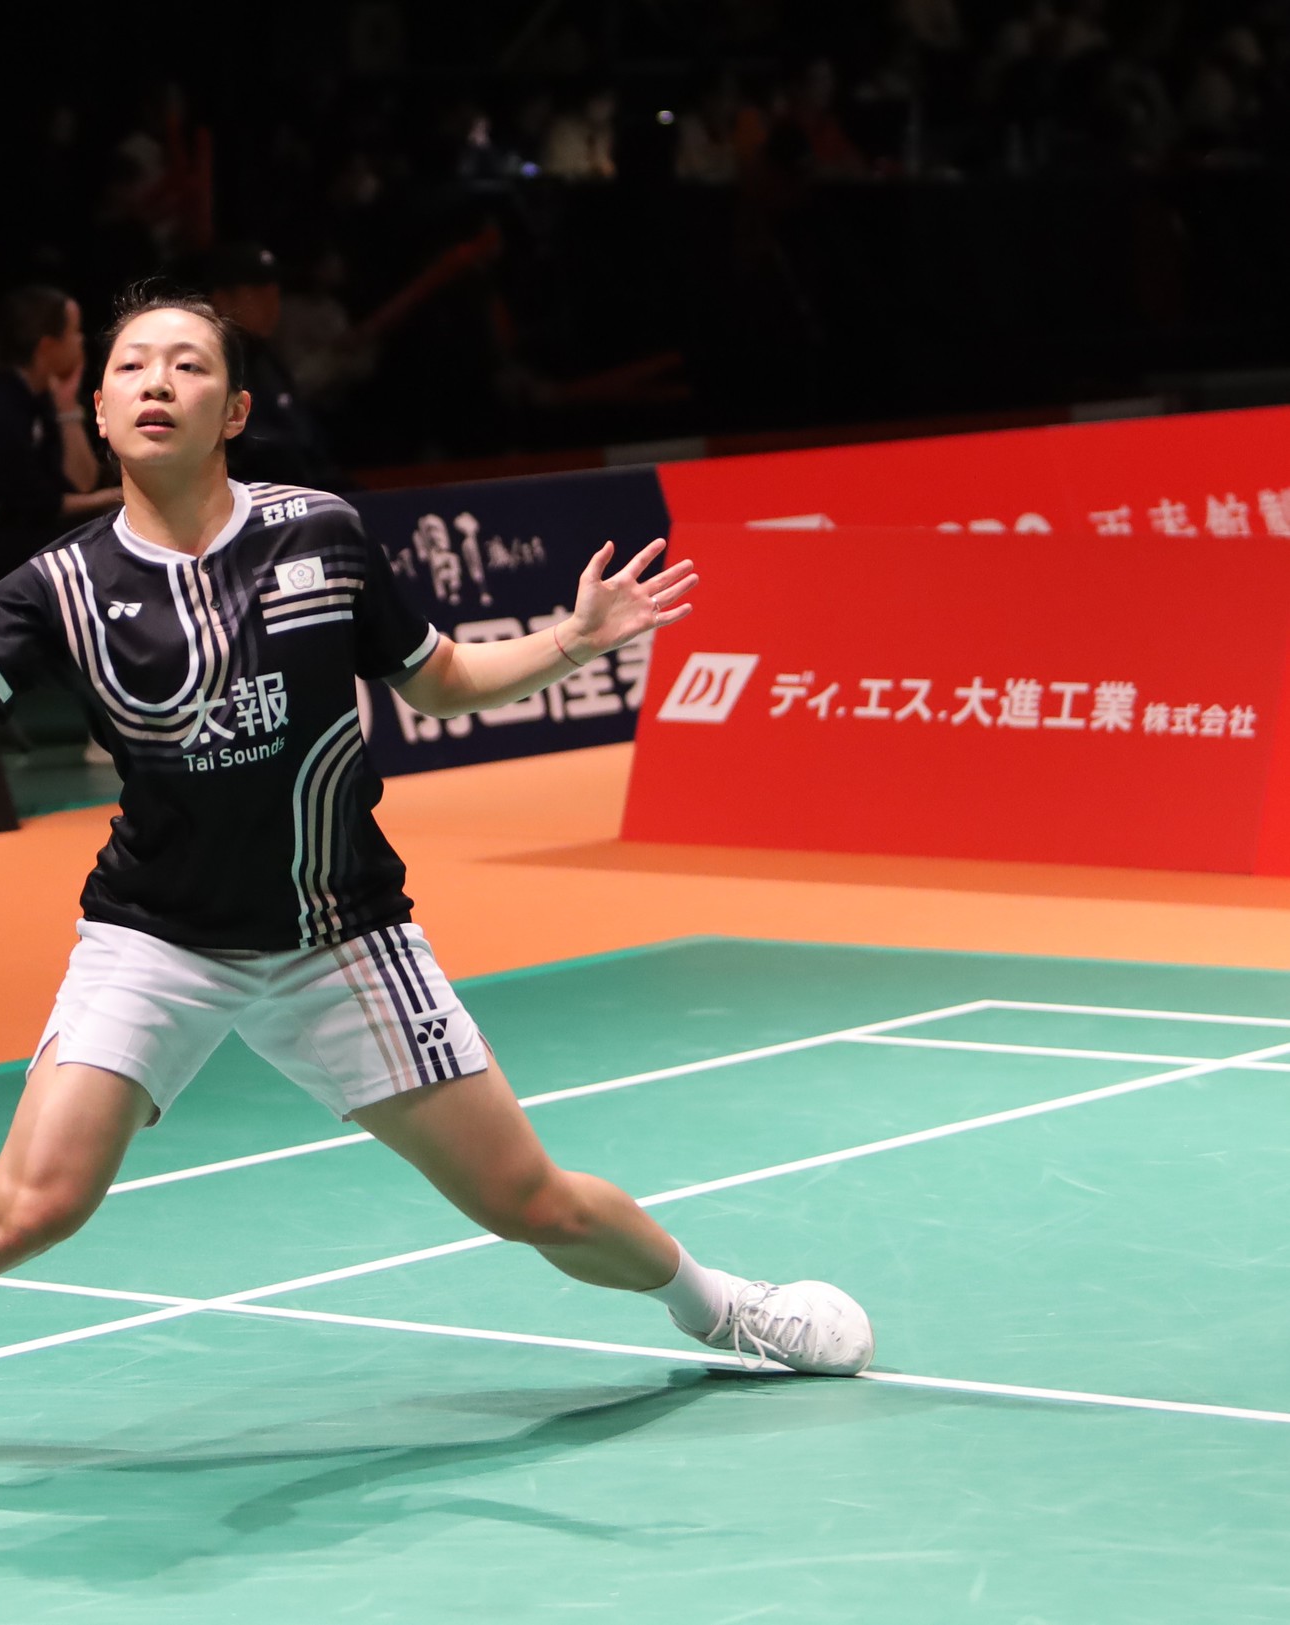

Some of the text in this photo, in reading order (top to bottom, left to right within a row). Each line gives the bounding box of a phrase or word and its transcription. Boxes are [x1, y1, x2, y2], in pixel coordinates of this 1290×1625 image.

[178, 671, 289, 749] 太報
[1142, 703, 1258, 738] 株式会社
[183, 737, 285, 772] Tai Sounds
